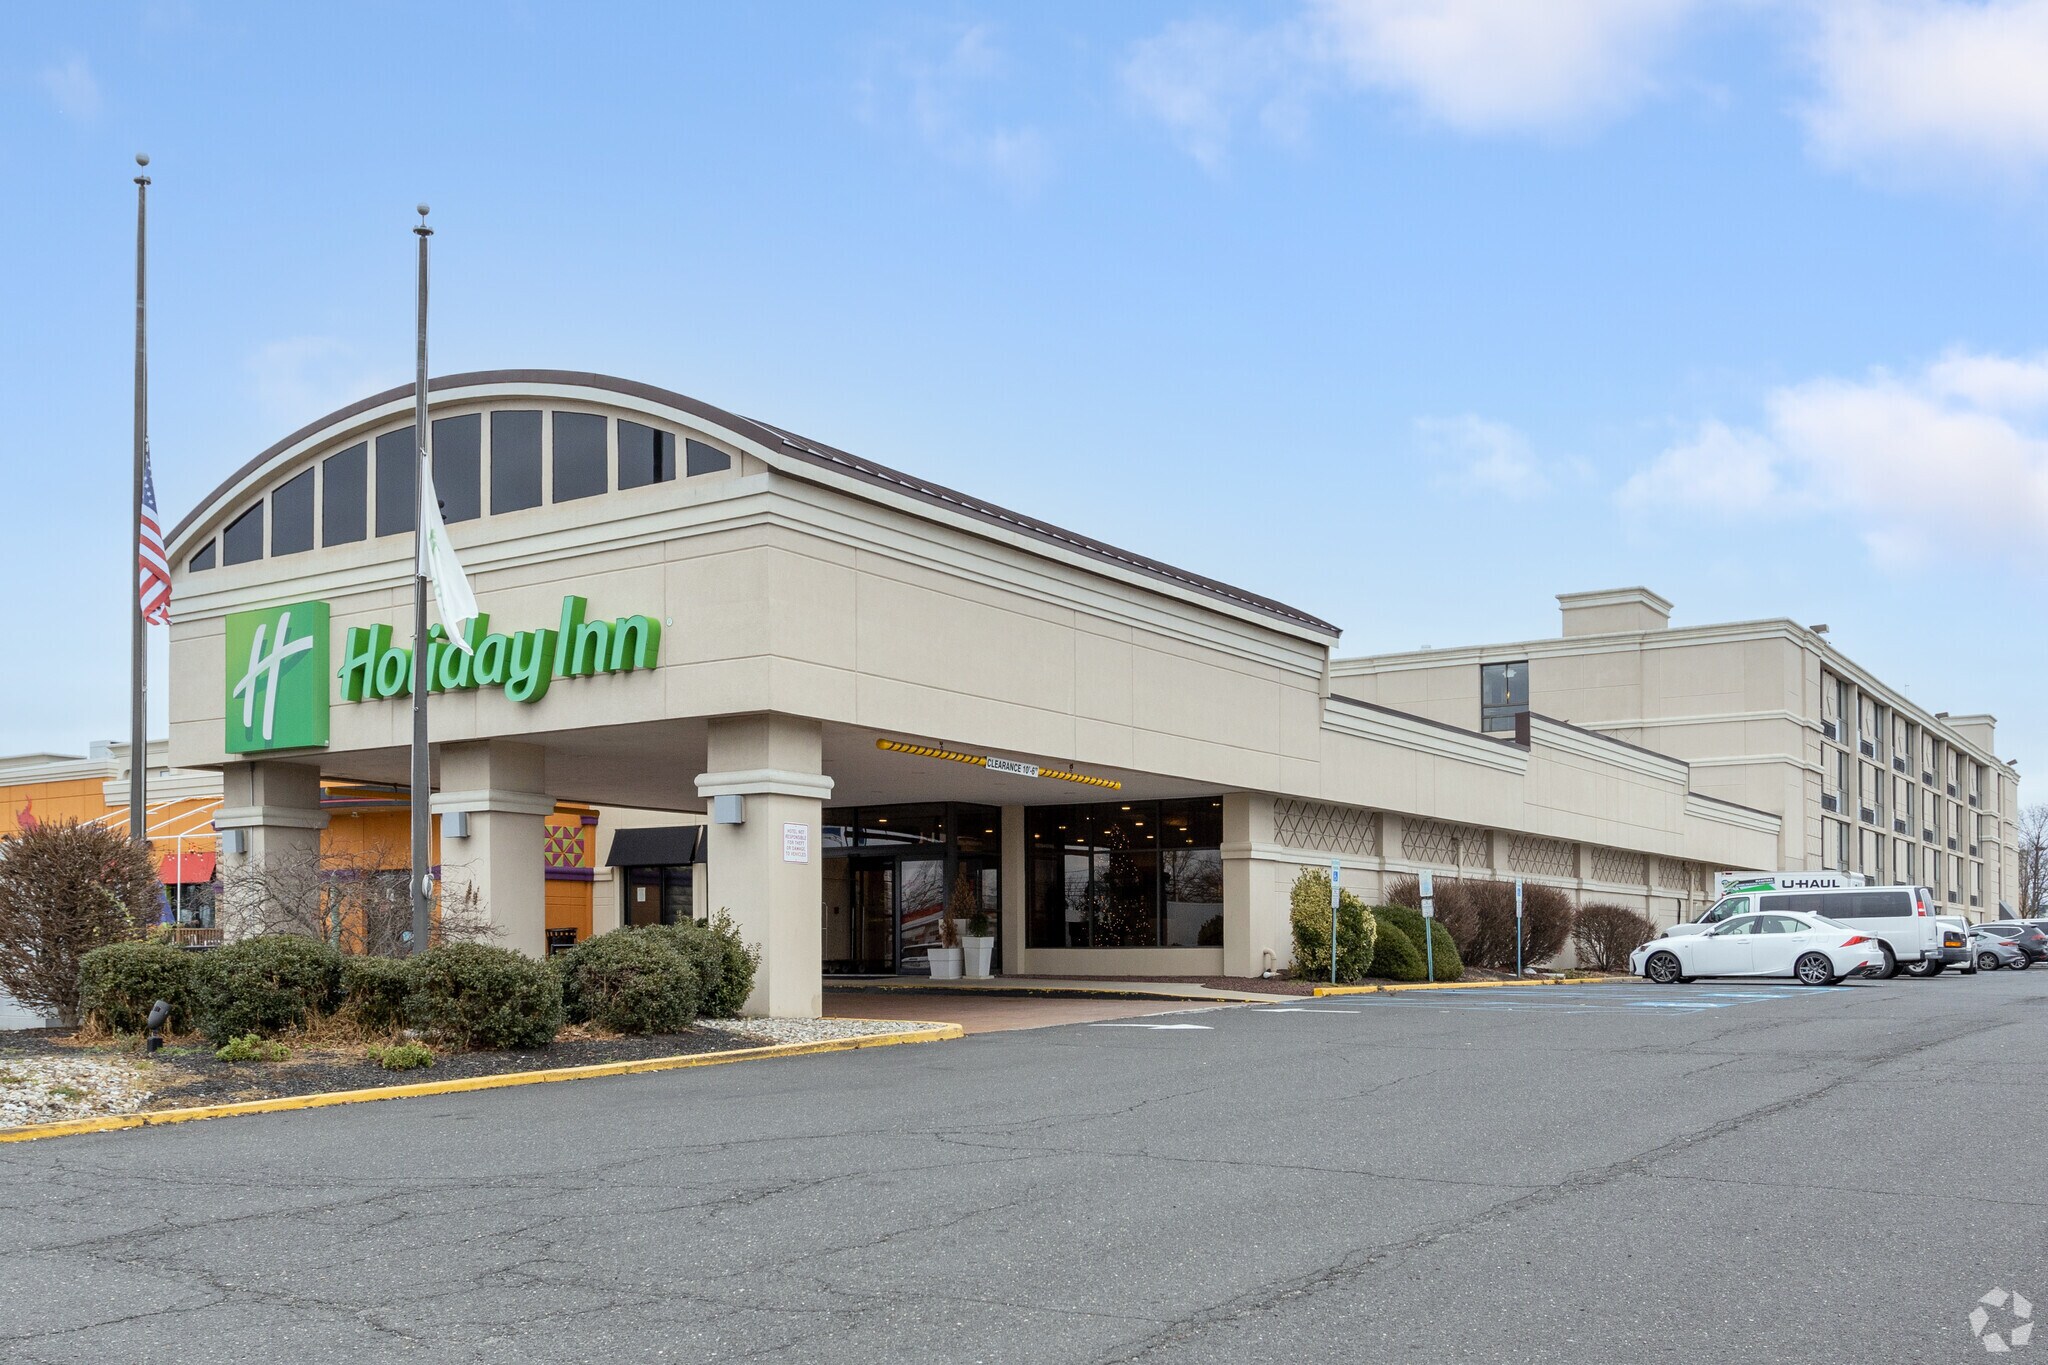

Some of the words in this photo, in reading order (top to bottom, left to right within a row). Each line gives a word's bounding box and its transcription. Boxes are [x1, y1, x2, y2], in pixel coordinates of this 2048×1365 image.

[338, 612, 557, 703] Hoiday
[555, 595, 661, 679] Inn
[987, 759, 1021, 772] CLEARANCE
[1782, 880, 1840, 888] U-HAUL
